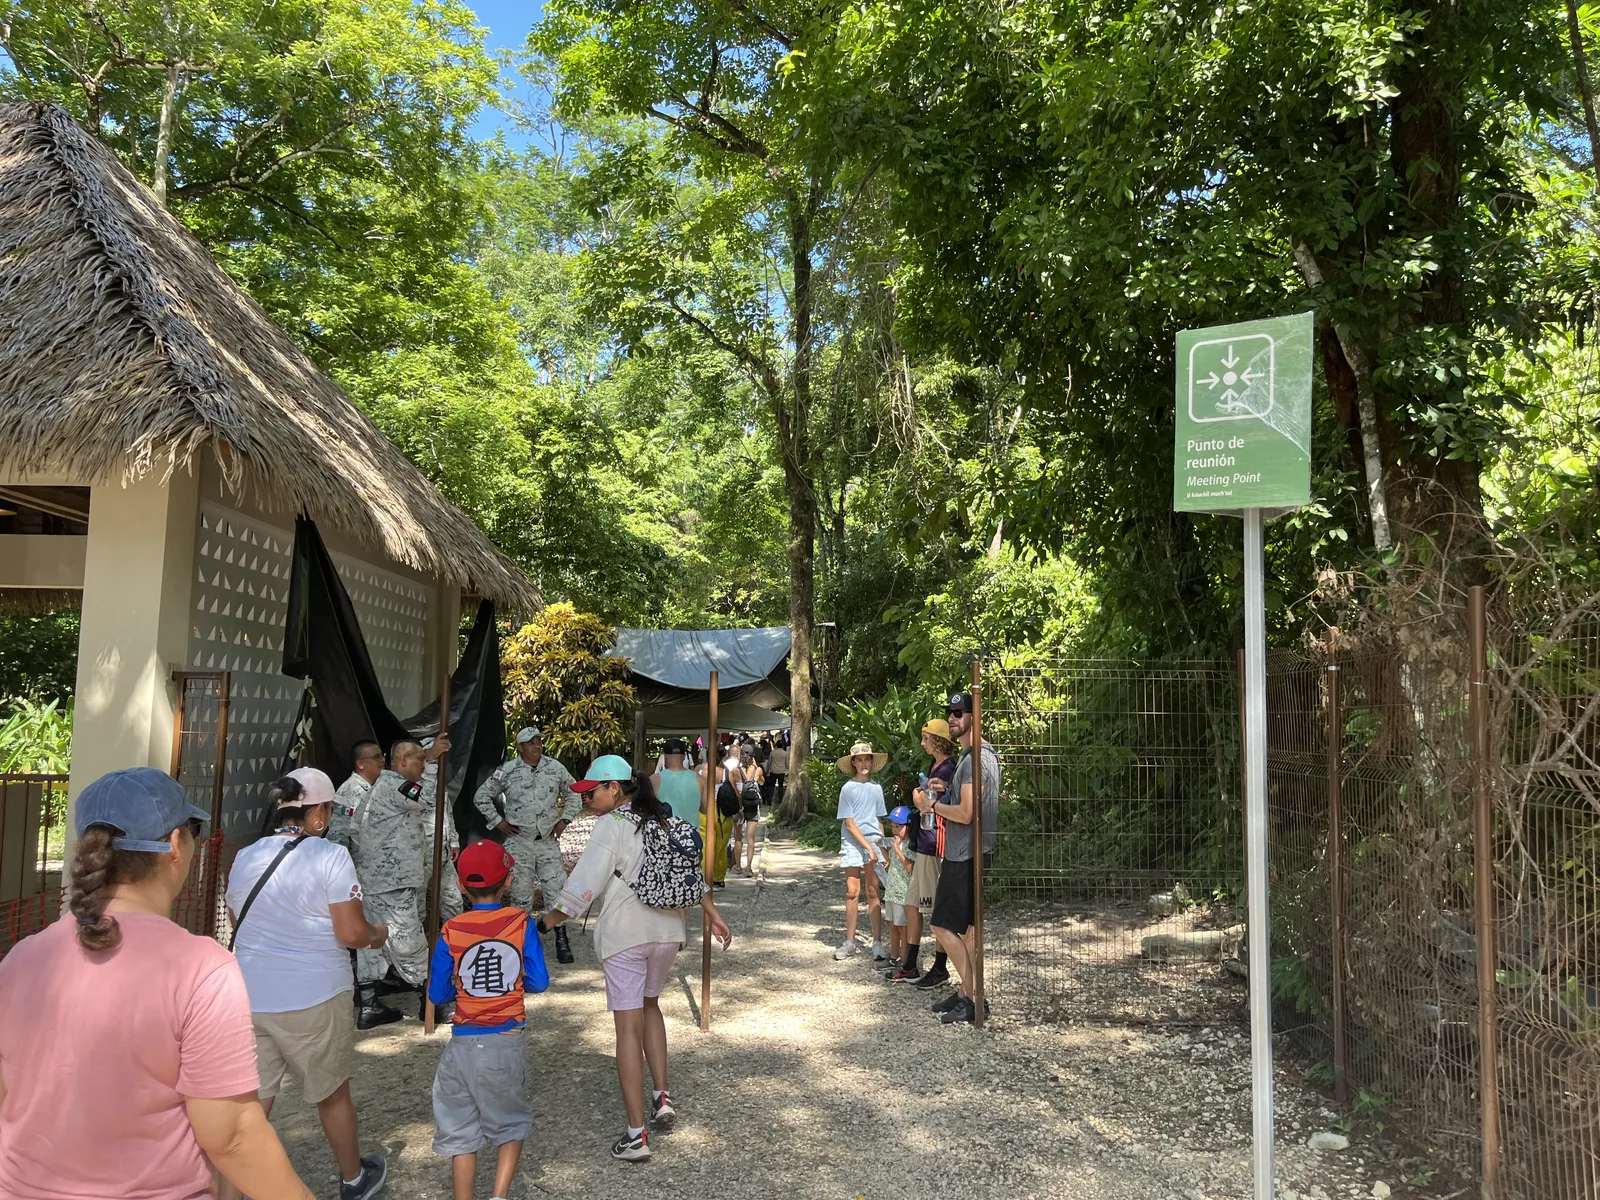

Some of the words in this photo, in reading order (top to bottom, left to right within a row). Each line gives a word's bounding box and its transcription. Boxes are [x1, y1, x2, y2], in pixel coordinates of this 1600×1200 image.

[1187, 439, 1224, 452] Punto
[1228, 435, 1245, 449] de
[1186, 453, 1235, 469] reunión
[1186, 474, 1230, 487] Meeting
[1232, 472, 1262, 484] Point
